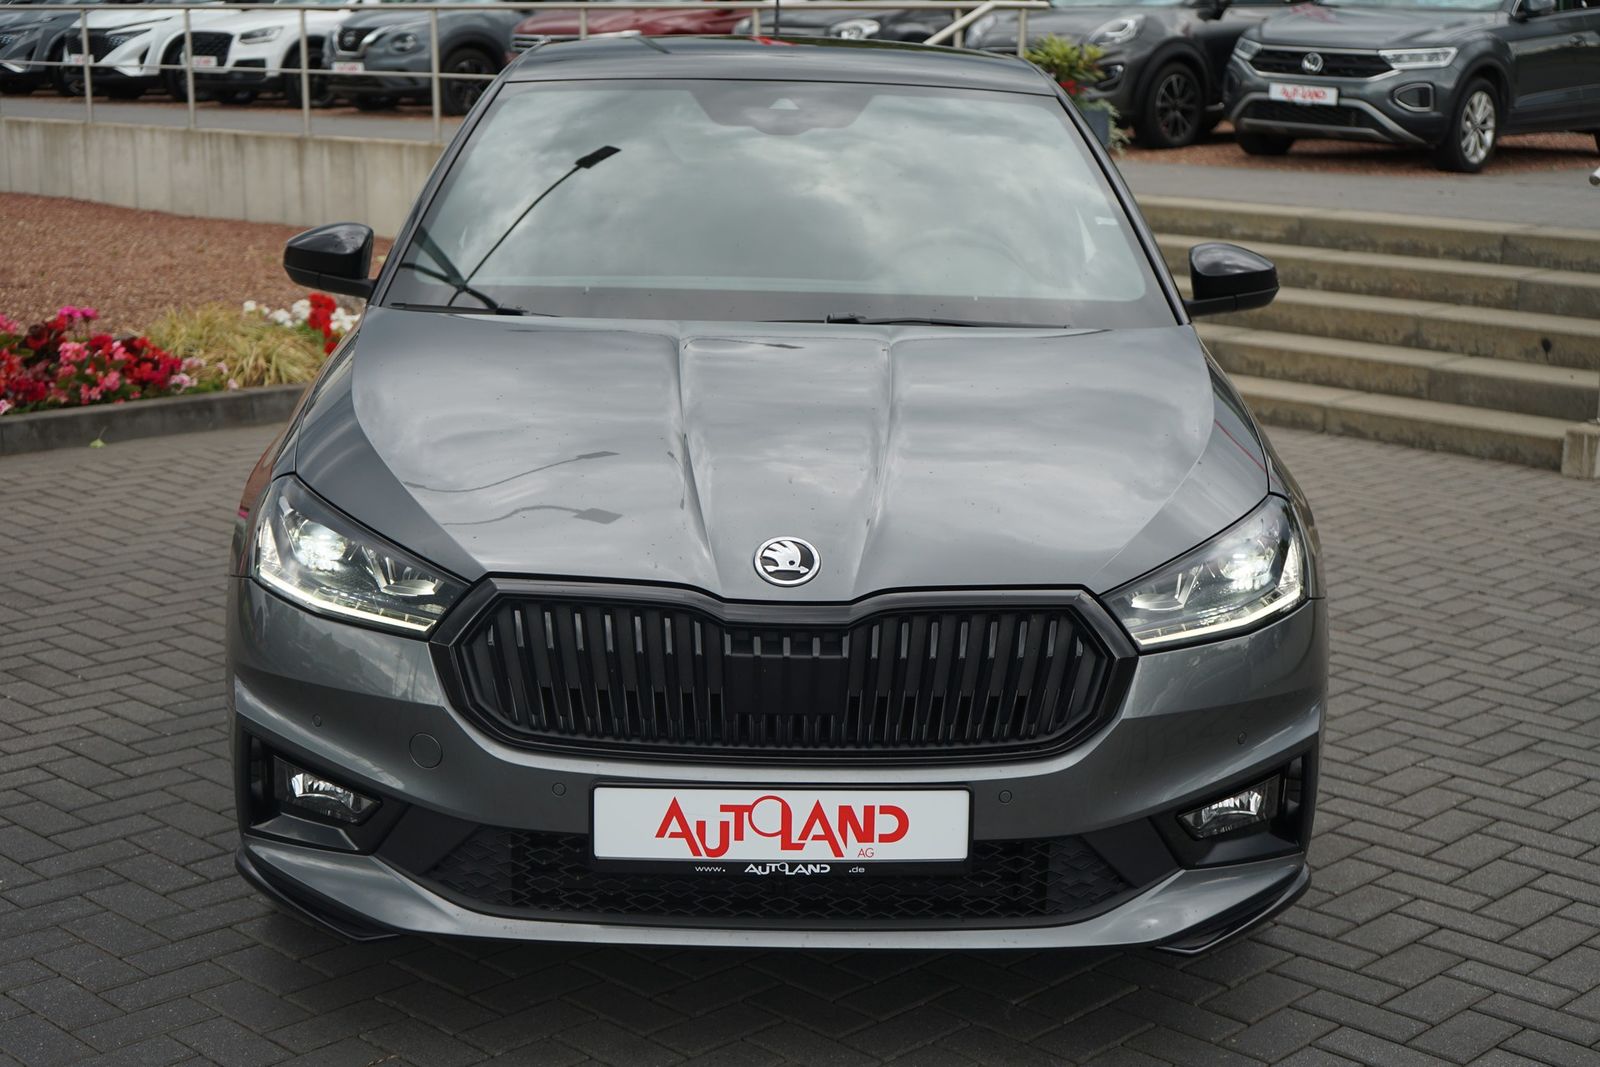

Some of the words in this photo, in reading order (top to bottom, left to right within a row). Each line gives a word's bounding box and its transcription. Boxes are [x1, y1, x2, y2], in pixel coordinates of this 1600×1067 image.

[655, 795, 909, 859] AUTOLAND
[857, 847, 875, 859] AG
[694, 865, 726, 873] www.
[744, 861, 831, 876] AUTOLAND
[848, 865, 866, 874] .de
